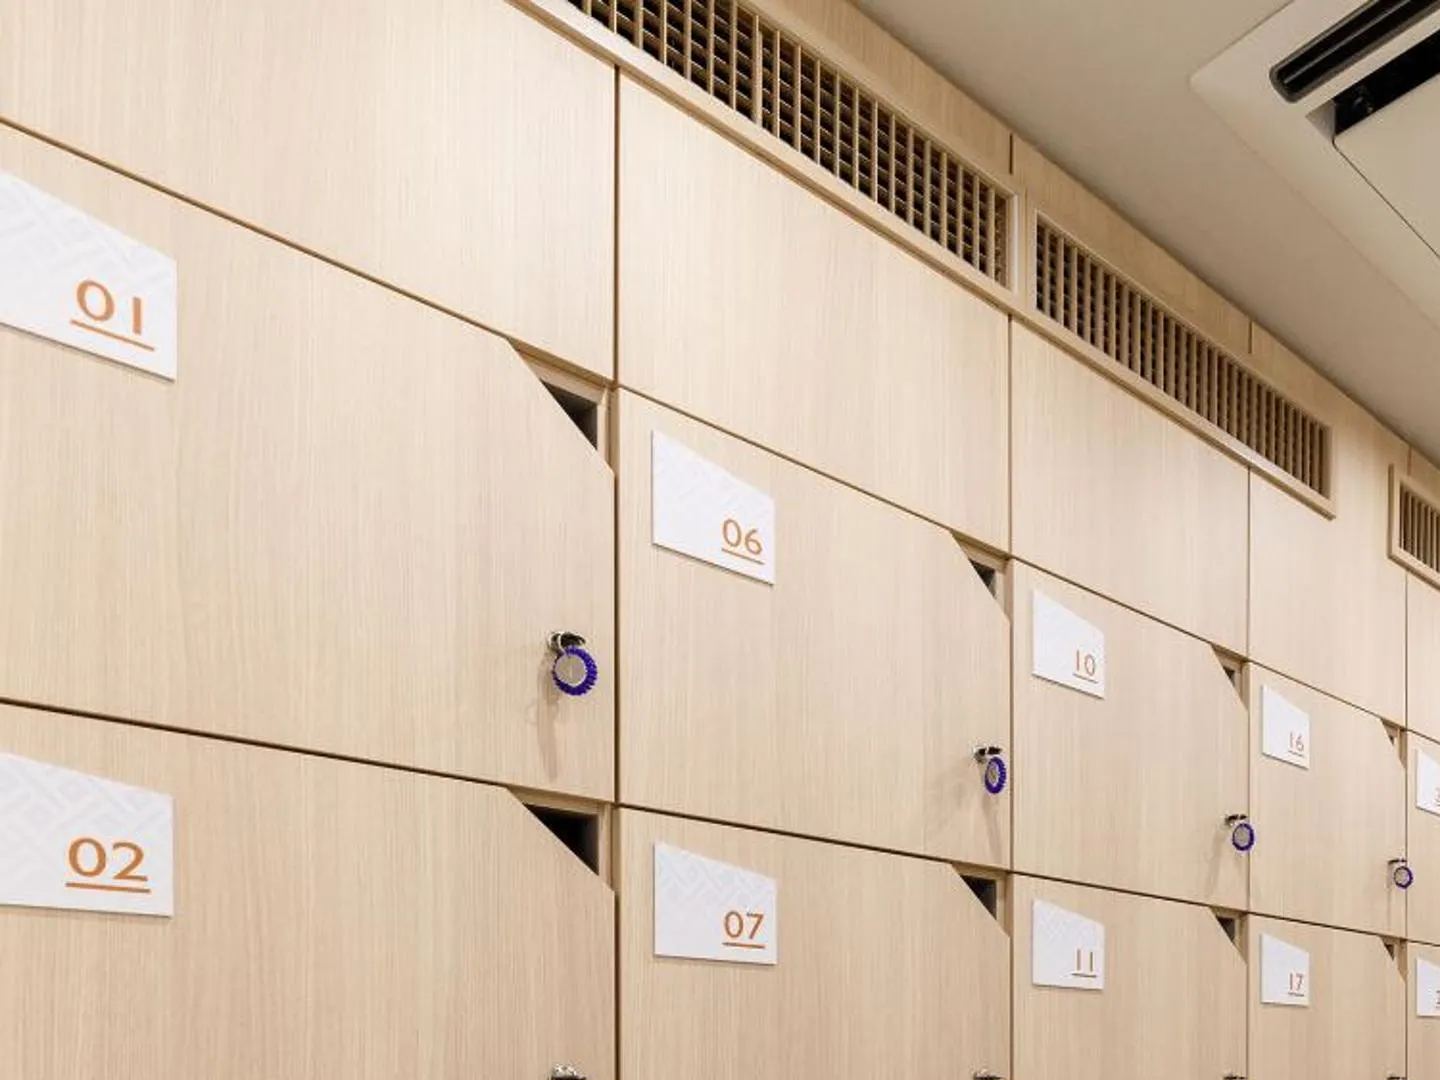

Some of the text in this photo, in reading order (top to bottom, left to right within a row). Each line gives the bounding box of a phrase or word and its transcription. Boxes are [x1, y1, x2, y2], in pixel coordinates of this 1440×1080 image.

[77, 281, 141, 334] 01
[723, 520, 762, 554] 06
[1076, 650, 1096, 676] 10
[1289, 731, 1304, 751] 16
[69, 838, 147, 881] 02
[725, 911, 763, 939] 07
[1077, 950, 1094, 971] 11
[1289, 973, 1303, 990] 17
